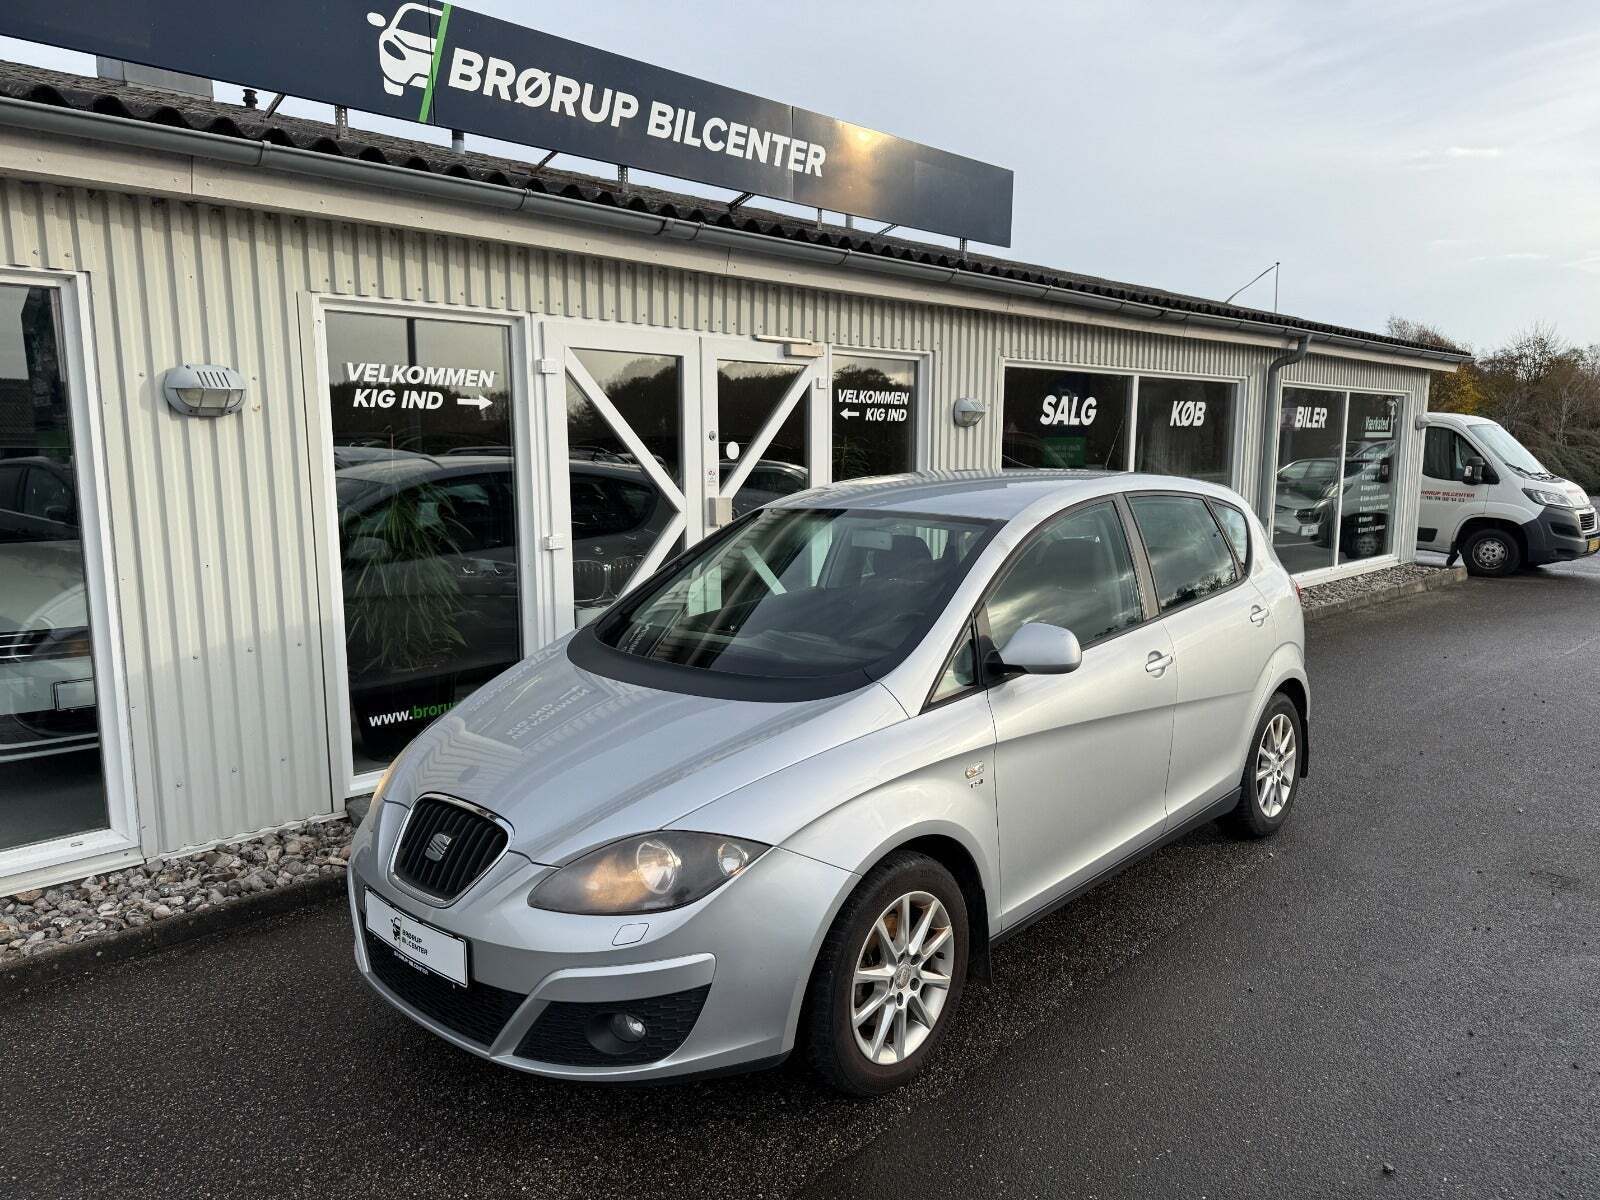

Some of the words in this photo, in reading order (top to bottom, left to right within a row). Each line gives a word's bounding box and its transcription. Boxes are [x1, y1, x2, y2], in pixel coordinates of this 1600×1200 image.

[448, 47, 639, 129] BRØRUP
[646, 101, 826, 178] BILCENTER
[346, 362, 496, 388] VELKOMMEN
[353, 388, 396, 408] KIG
[401, 390, 444, 410] IND
[837, 388, 910, 405] VELKOMMEN
[865, 407, 886, 422] KIG
[887, 408, 907, 422] IND
[1039, 394, 1097, 426] SALG
[1169, 400, 1207, 427] KØB
[1294, 406, 1328, 429] BILER
